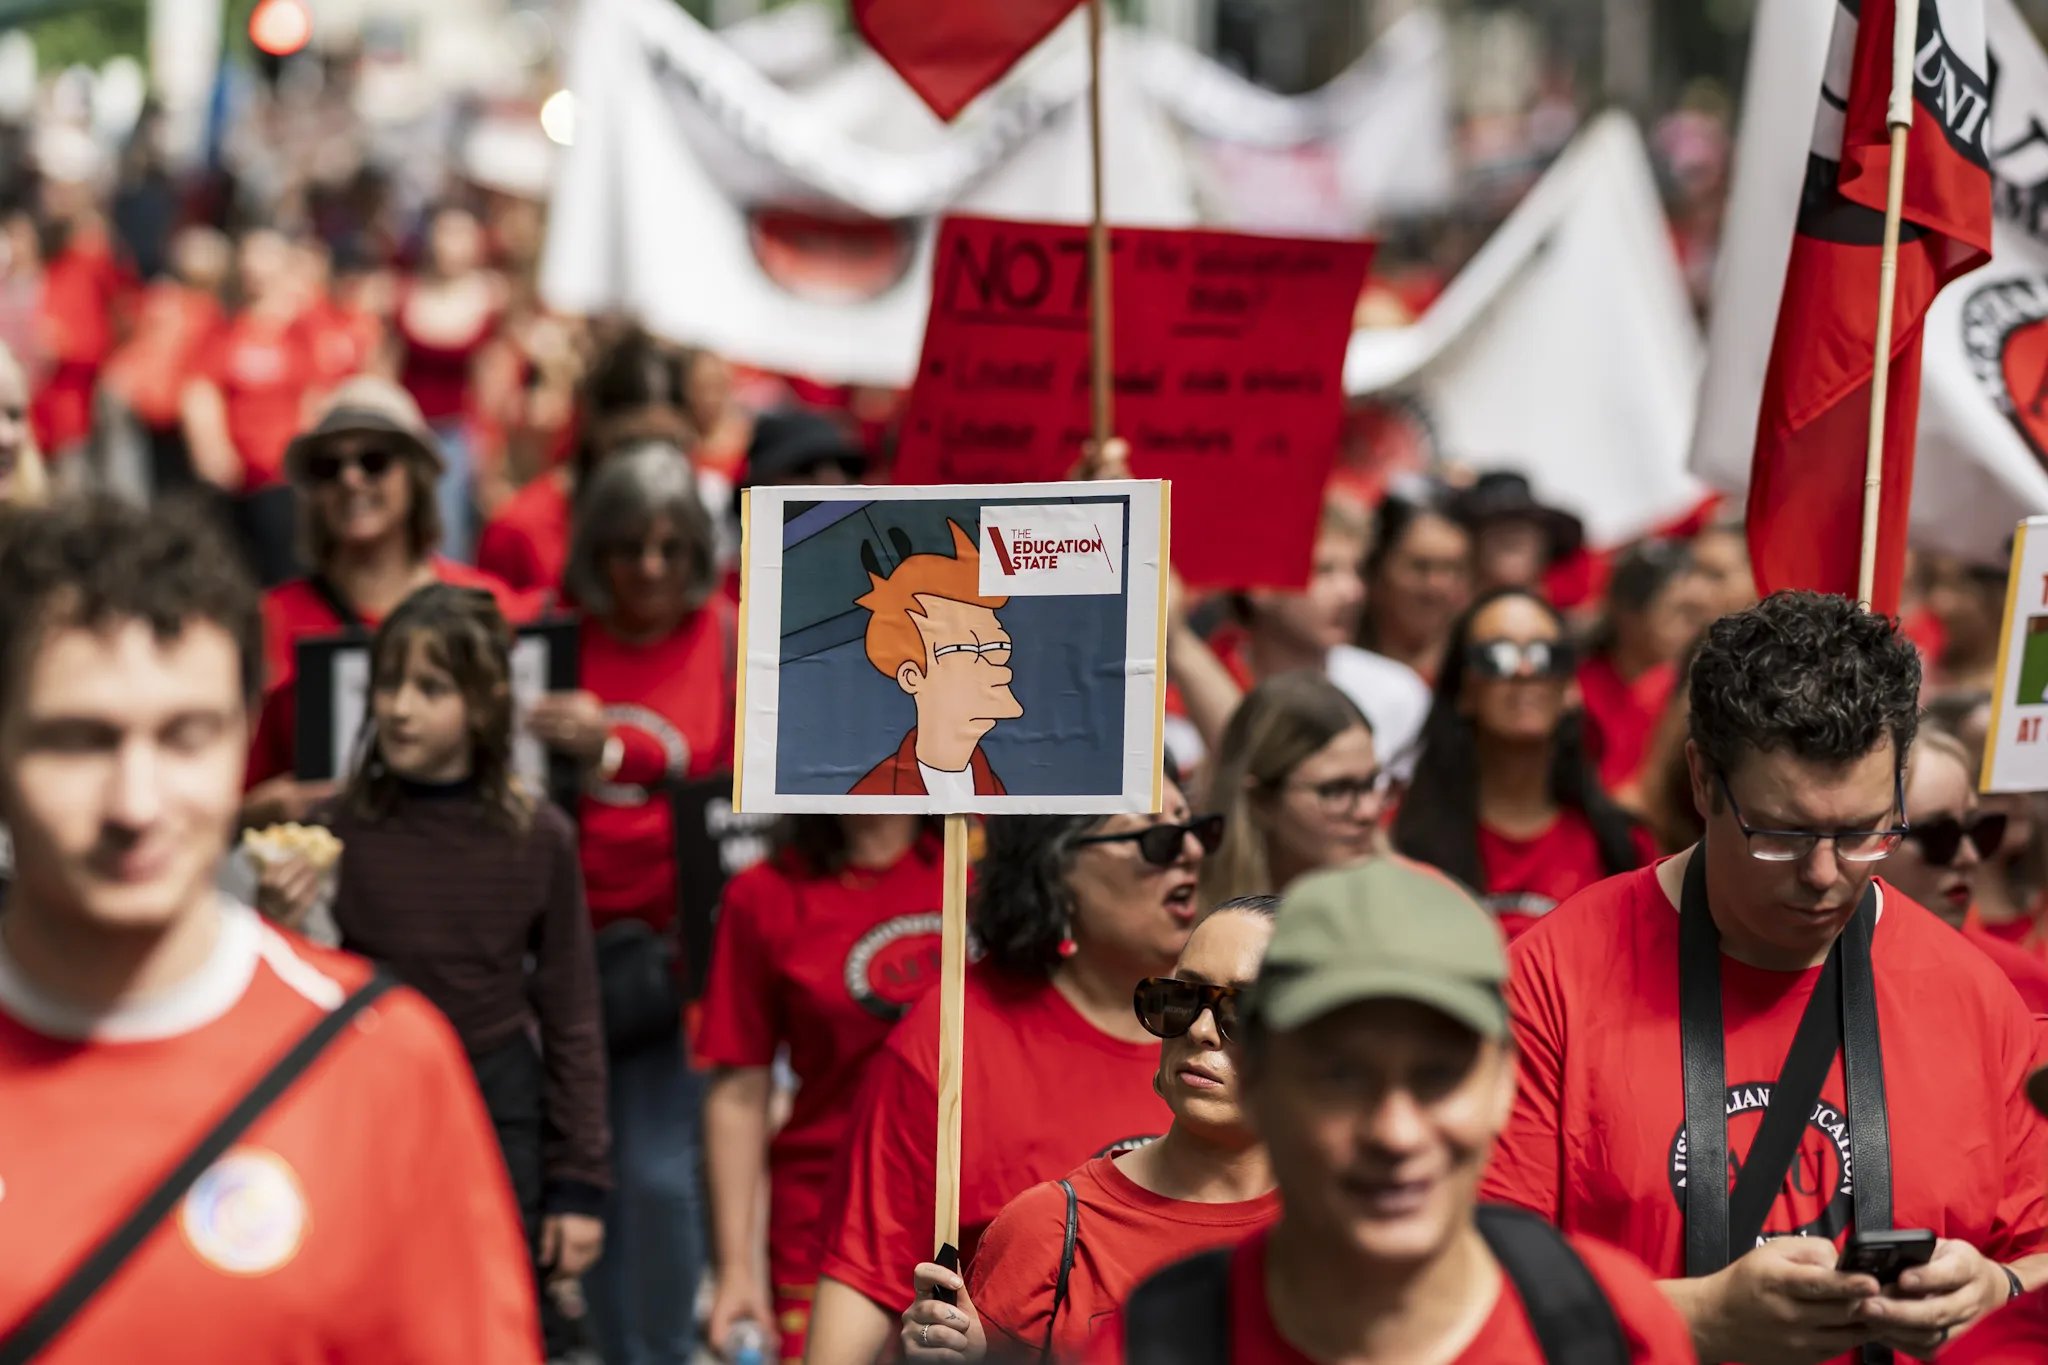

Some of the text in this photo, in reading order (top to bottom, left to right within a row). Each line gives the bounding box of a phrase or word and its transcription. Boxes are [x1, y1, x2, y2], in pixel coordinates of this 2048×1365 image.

[942, 233, 1122, 314] NOT
[1011, 528, 1032, 539] THE
[1013, 538, 1102, 554] EDUCATION
[1012, 555, 1058, 570] STATE
[2015, 717, 2042, 744] AT
